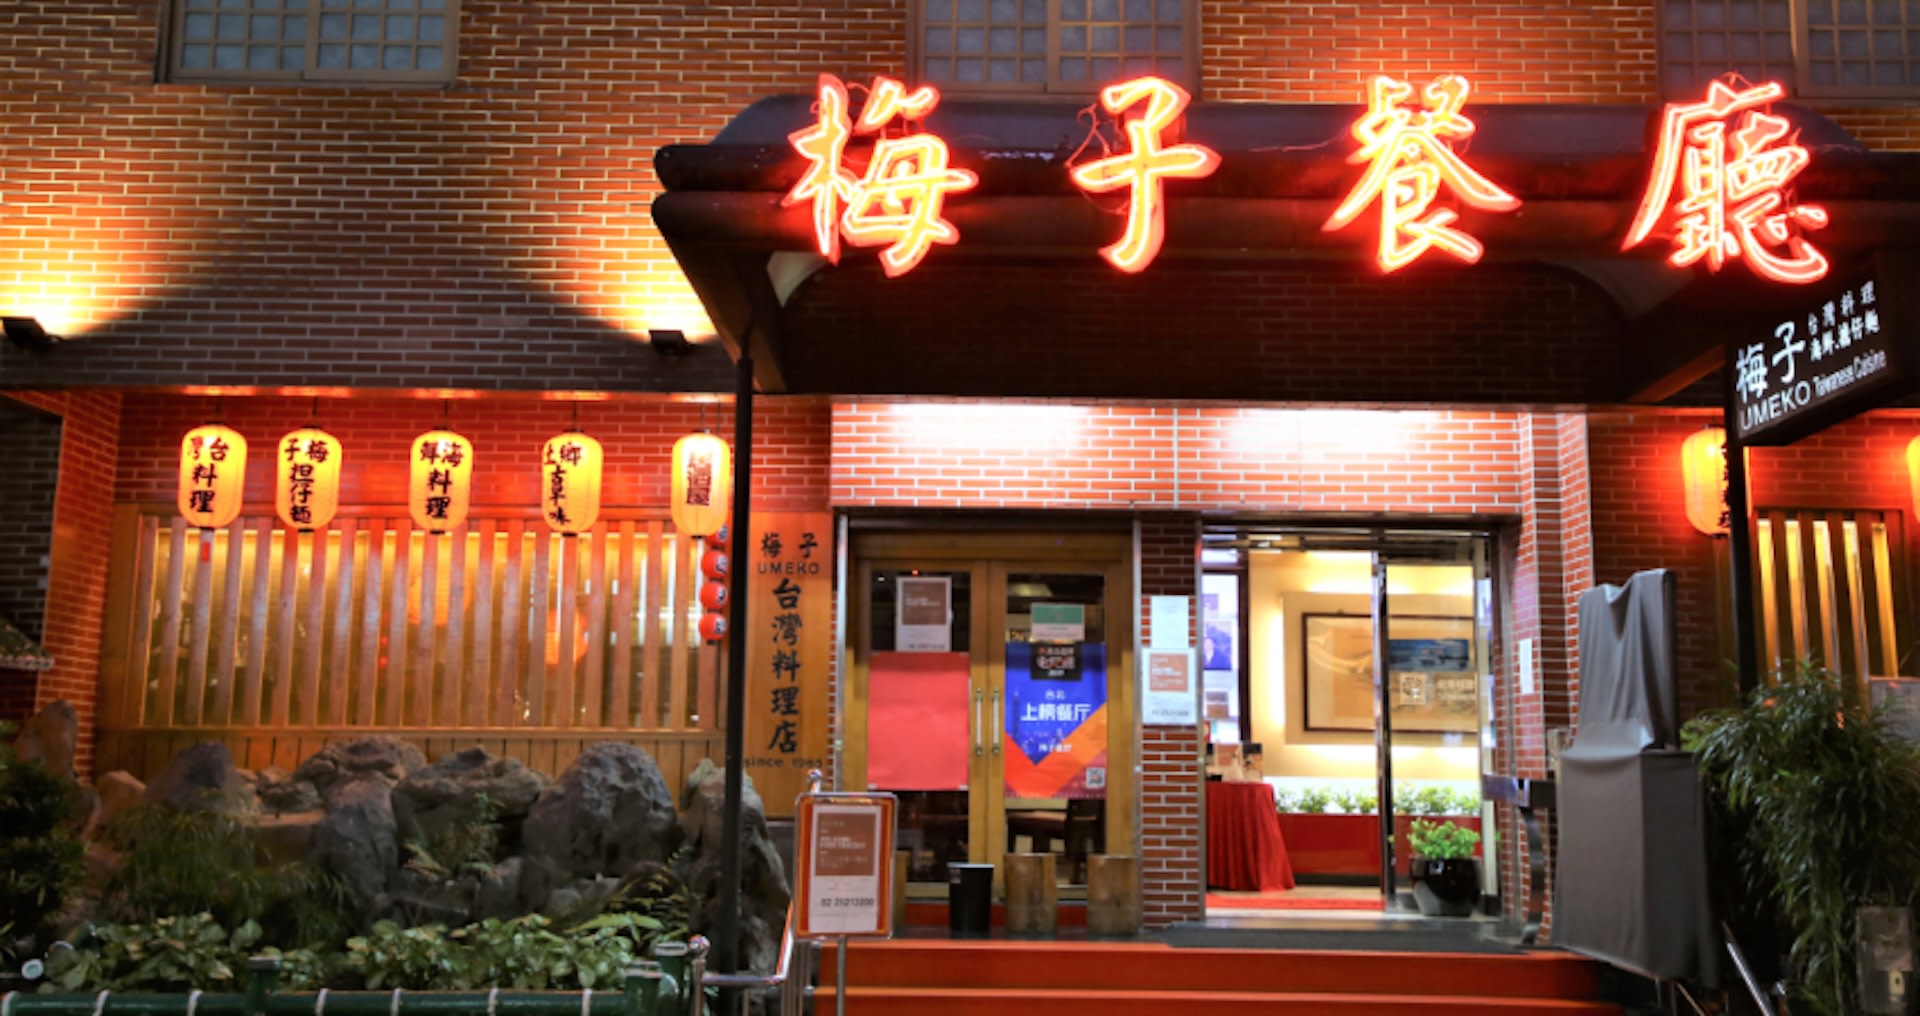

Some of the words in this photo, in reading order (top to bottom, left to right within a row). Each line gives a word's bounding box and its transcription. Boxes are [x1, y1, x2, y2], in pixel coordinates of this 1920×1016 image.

[781, 73, 1829, 283] 梅子餐廳
[1736, 321, 1806, 404] 梅子
[1741, 381, 1811, 430] UMEKO
[1813, 365, 1856, 398] Taiwanese
[1853, 349, 1887, 379] Cuisine
[758, 561, 820, 575] UMEKO
[761, 532, 818, 558] 梅子
[768, 578, 802, 754] 台灣料理店
[744, 756, 784, 768] since
